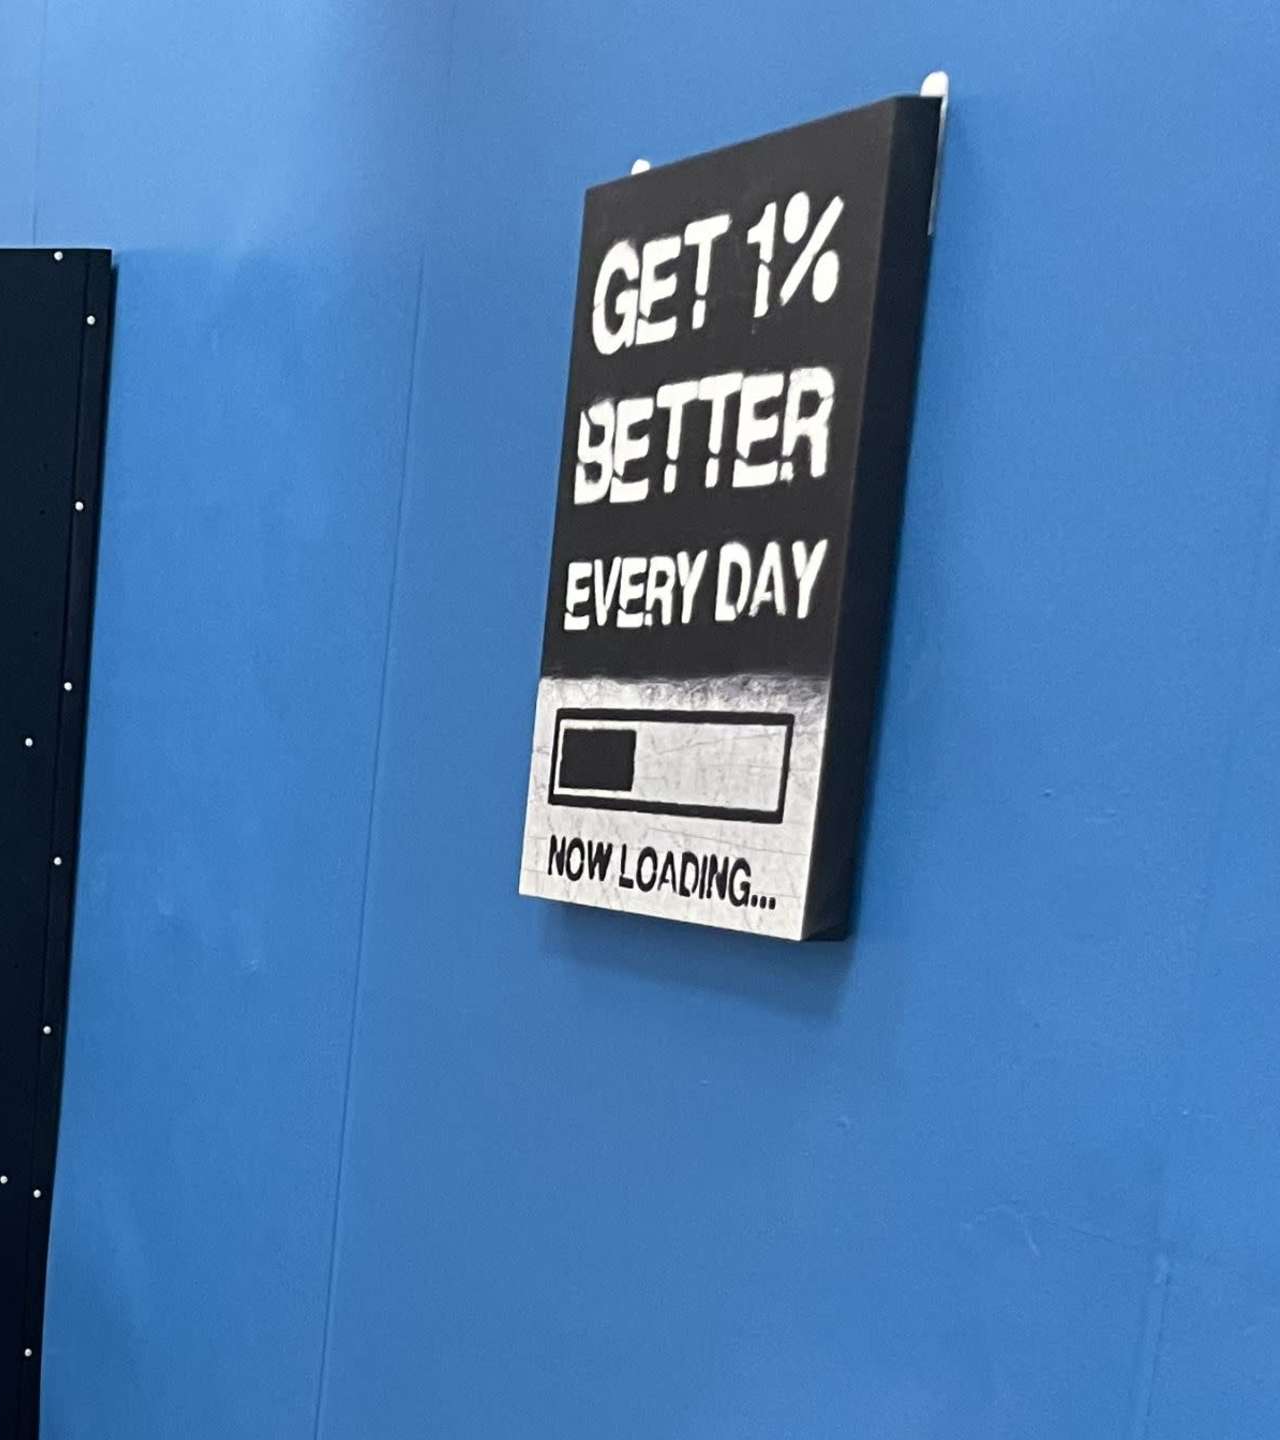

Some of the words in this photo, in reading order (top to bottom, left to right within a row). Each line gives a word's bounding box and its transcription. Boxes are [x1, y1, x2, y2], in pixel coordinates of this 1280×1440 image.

[591, 213, 733, 356] GET
[746, 191, 845, 319] 1%
[573, 365, 836, 505] BETTER
[563, 549, 709, 631] EVERY
[714, 538, 829, 622] DAY
[547, 834, 613, 883] NOW
[618, 843, 777, 911] LOADING...
